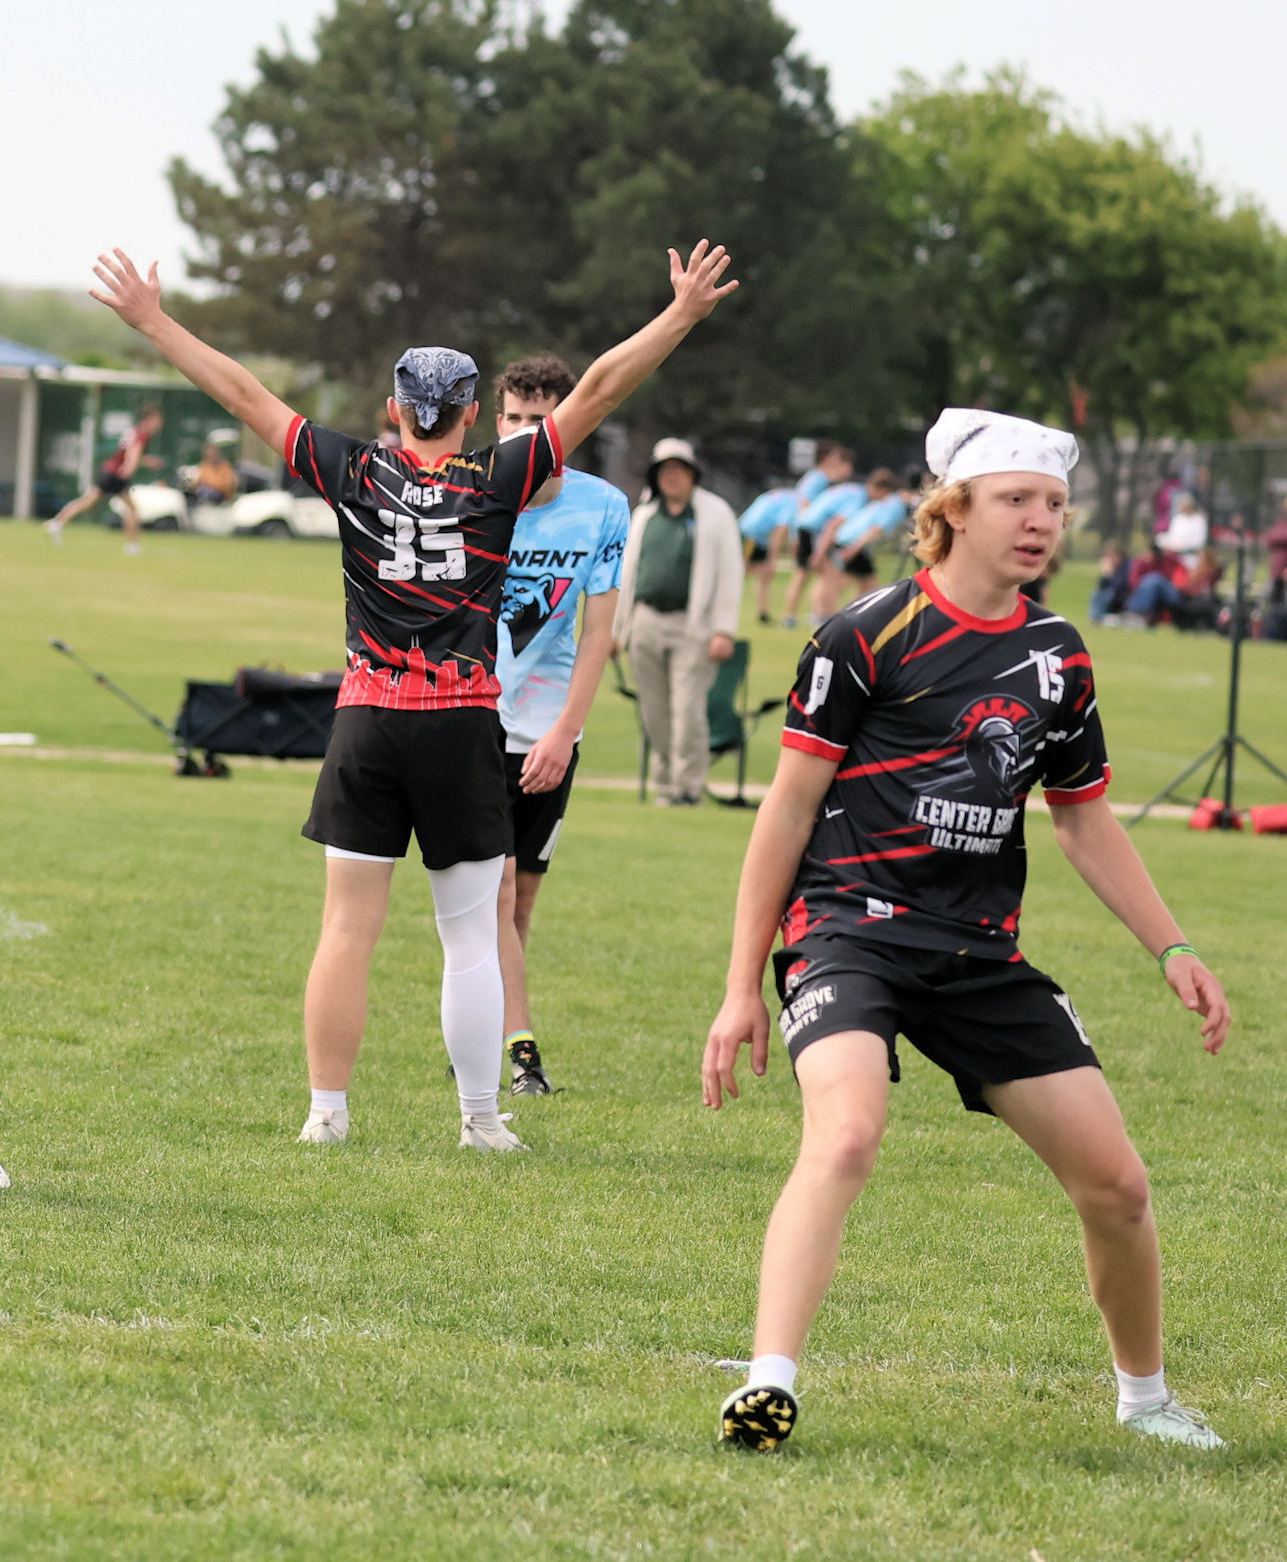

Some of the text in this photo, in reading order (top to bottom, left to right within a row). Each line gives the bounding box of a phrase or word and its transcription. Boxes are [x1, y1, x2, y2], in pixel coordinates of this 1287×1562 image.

[400, 480, 444, 507] ROSE
[377, 508, 466, 581] 35
[509, 550, 589, 568] NANT
[1029, 649, 1065, 705] 15
[915, 795, 992, 833] CENTER
[789, 985, 834, 1020] GROVE
